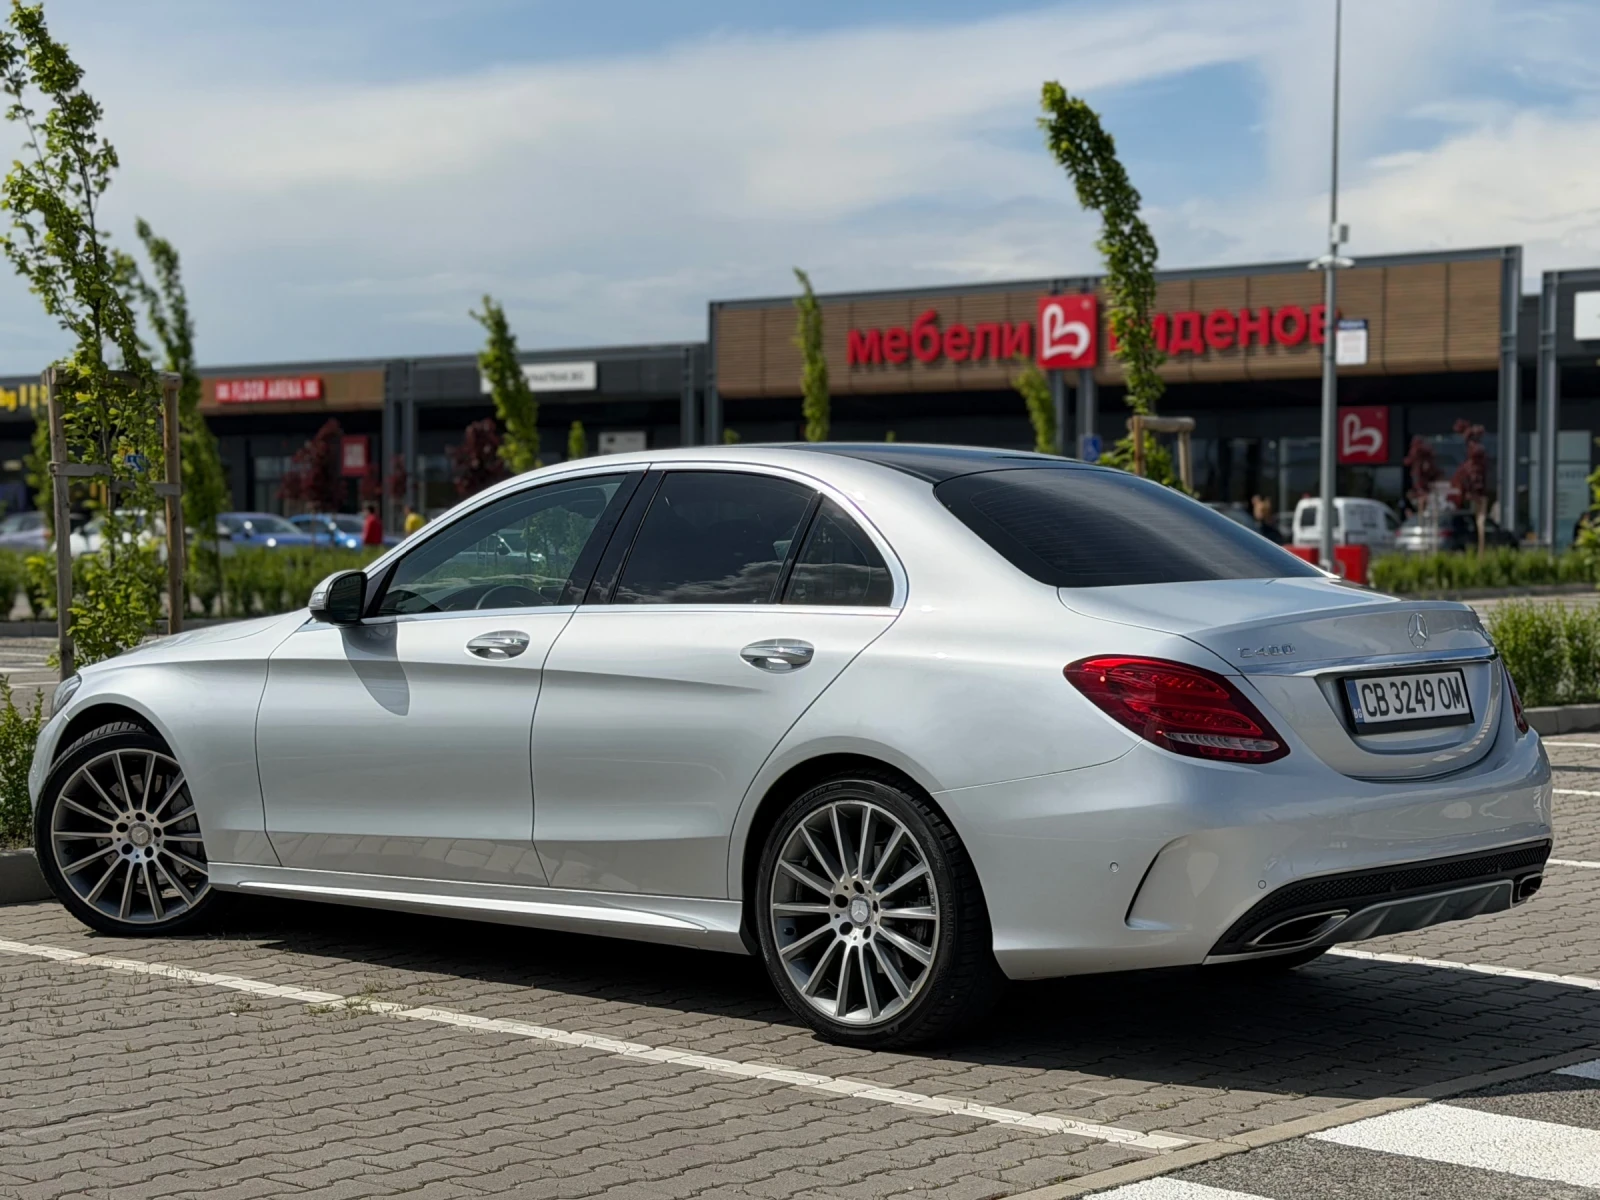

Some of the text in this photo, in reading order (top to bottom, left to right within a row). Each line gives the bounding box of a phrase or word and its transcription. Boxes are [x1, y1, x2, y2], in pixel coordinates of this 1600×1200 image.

[847, 307, 1031, 365] мебели
[1353, 708, 1363, 719] BG
[1361, 676, 1465, 718] CB 3249 OM
